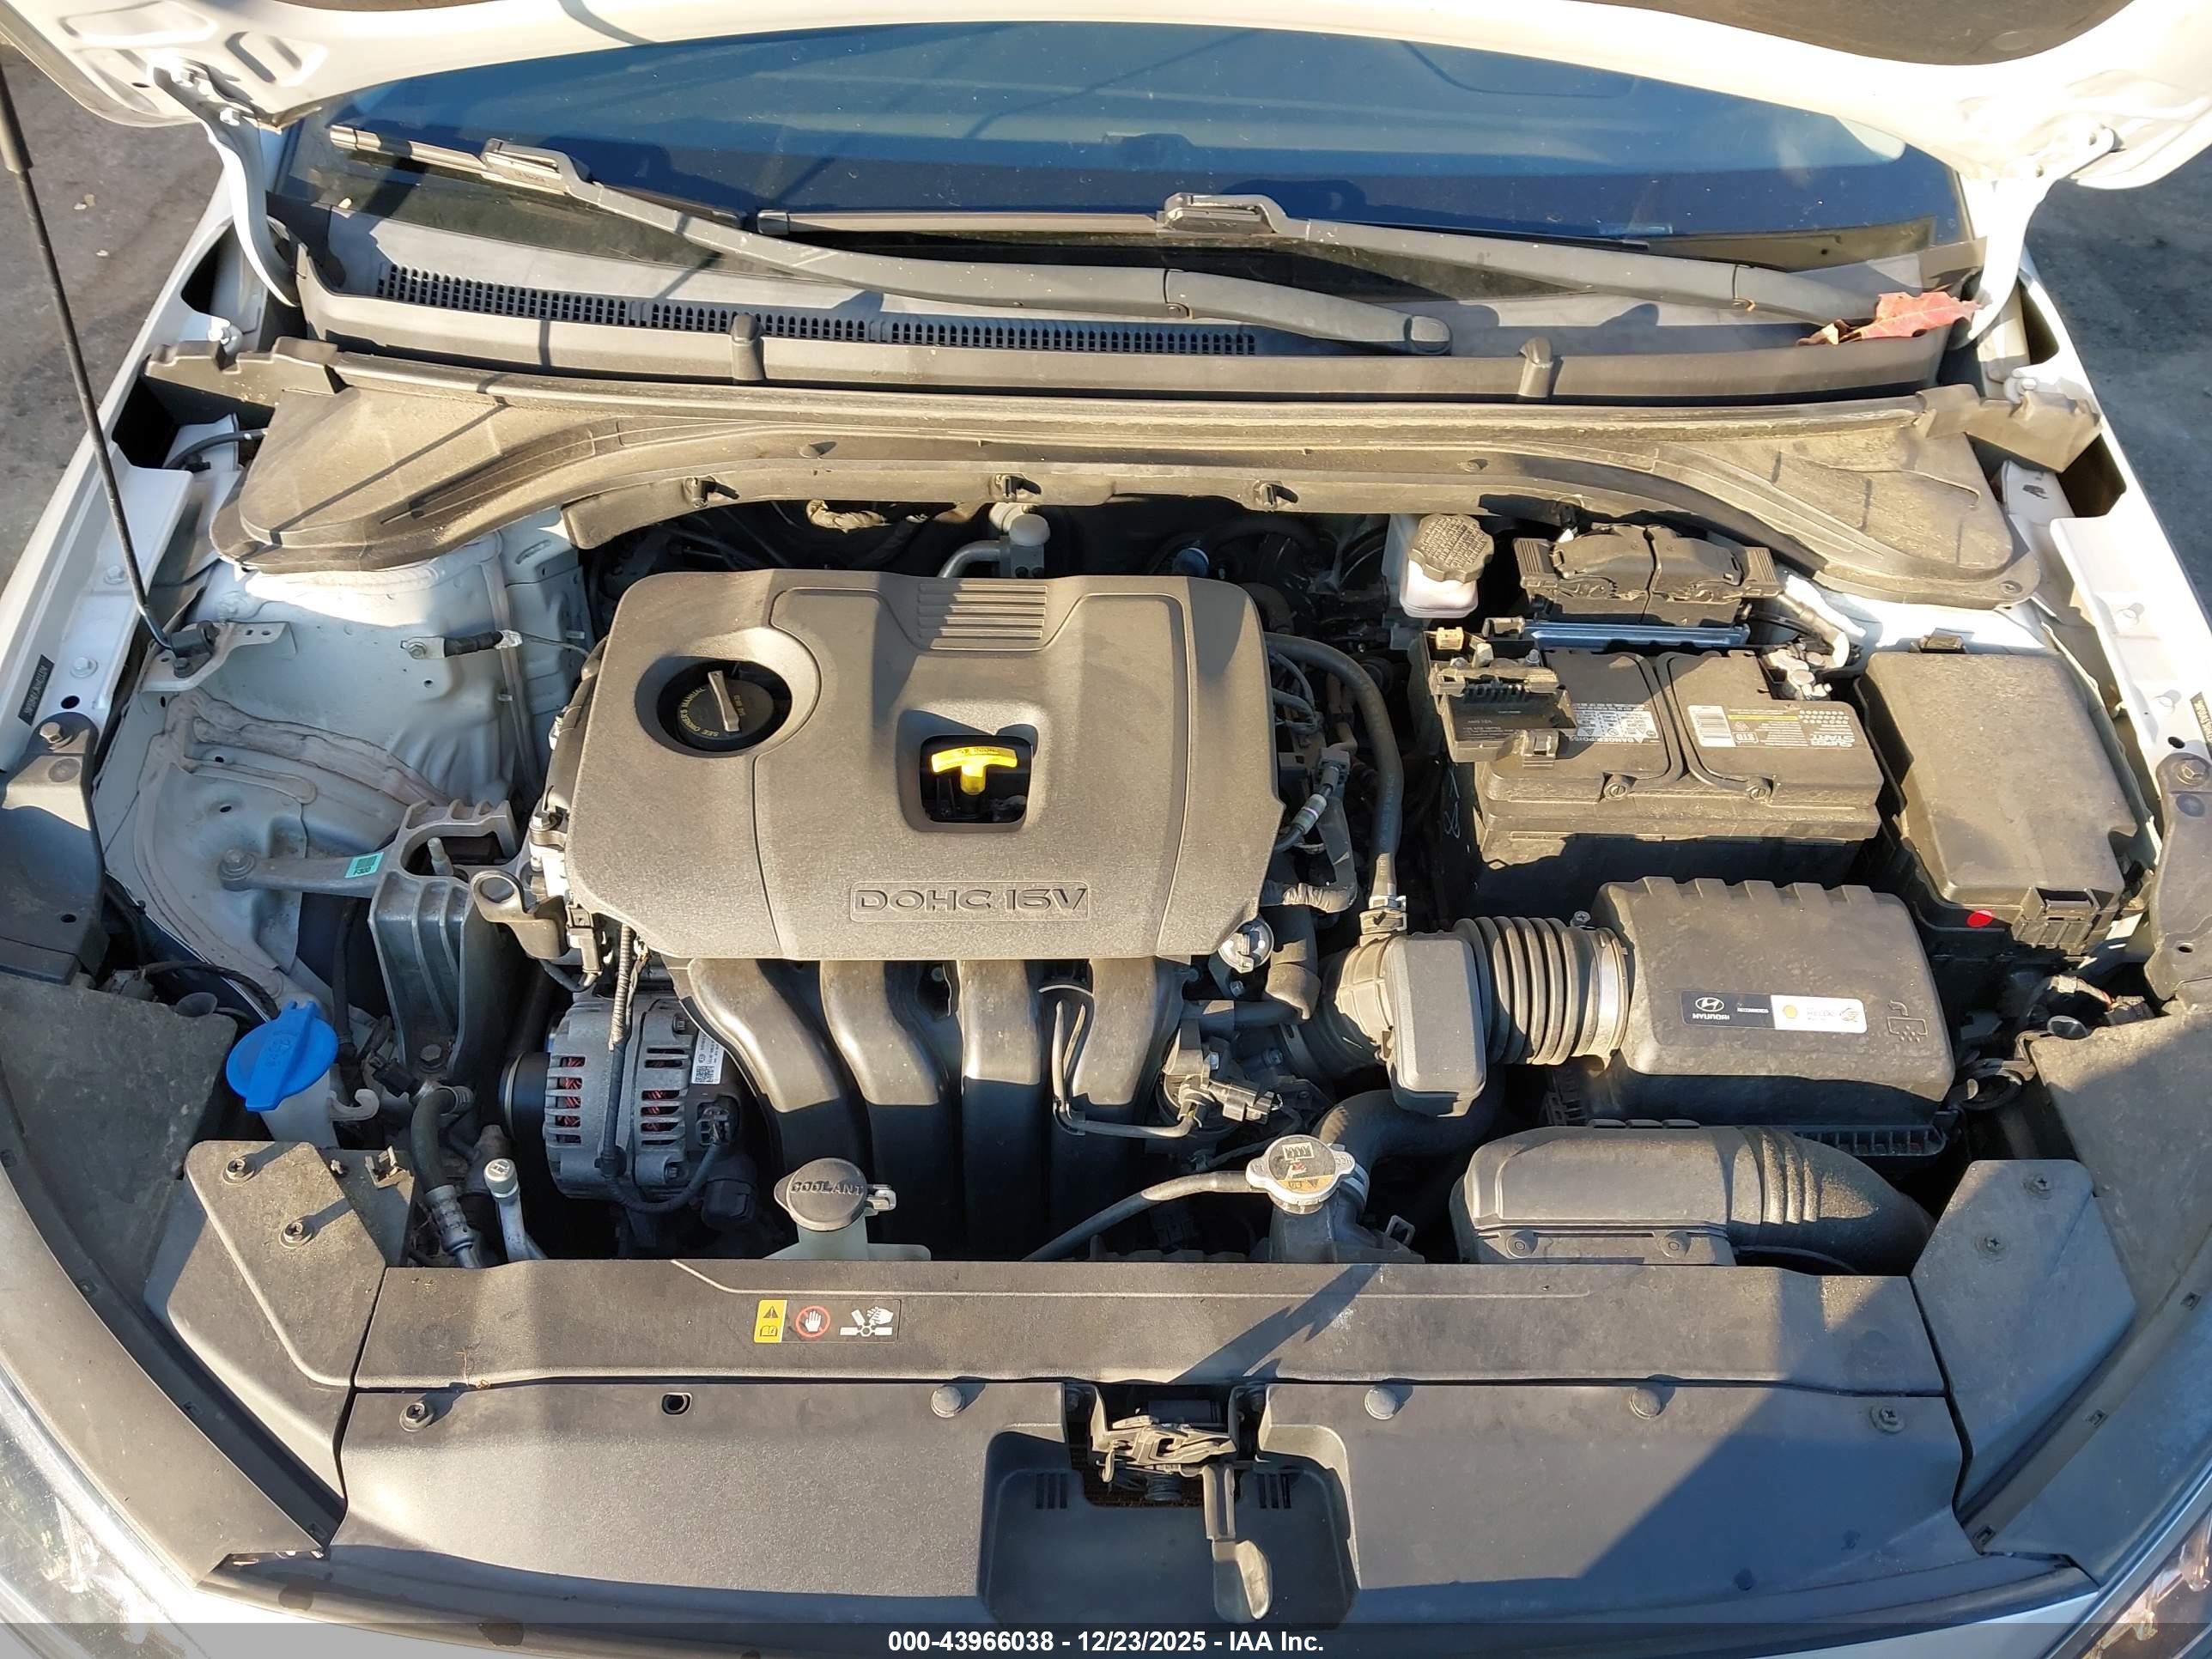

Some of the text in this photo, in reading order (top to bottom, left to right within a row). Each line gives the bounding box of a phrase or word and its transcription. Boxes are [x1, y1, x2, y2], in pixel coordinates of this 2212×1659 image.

[681, 687, 707, 707] MANUAL
[701, 728, 720, 737] SEE
[855, 888, 1088, 912] DOHC 16V
[1692, 1012, 1730, 1021] HYUNDAI
[791, 1180, 864, 1196] COOLANT
